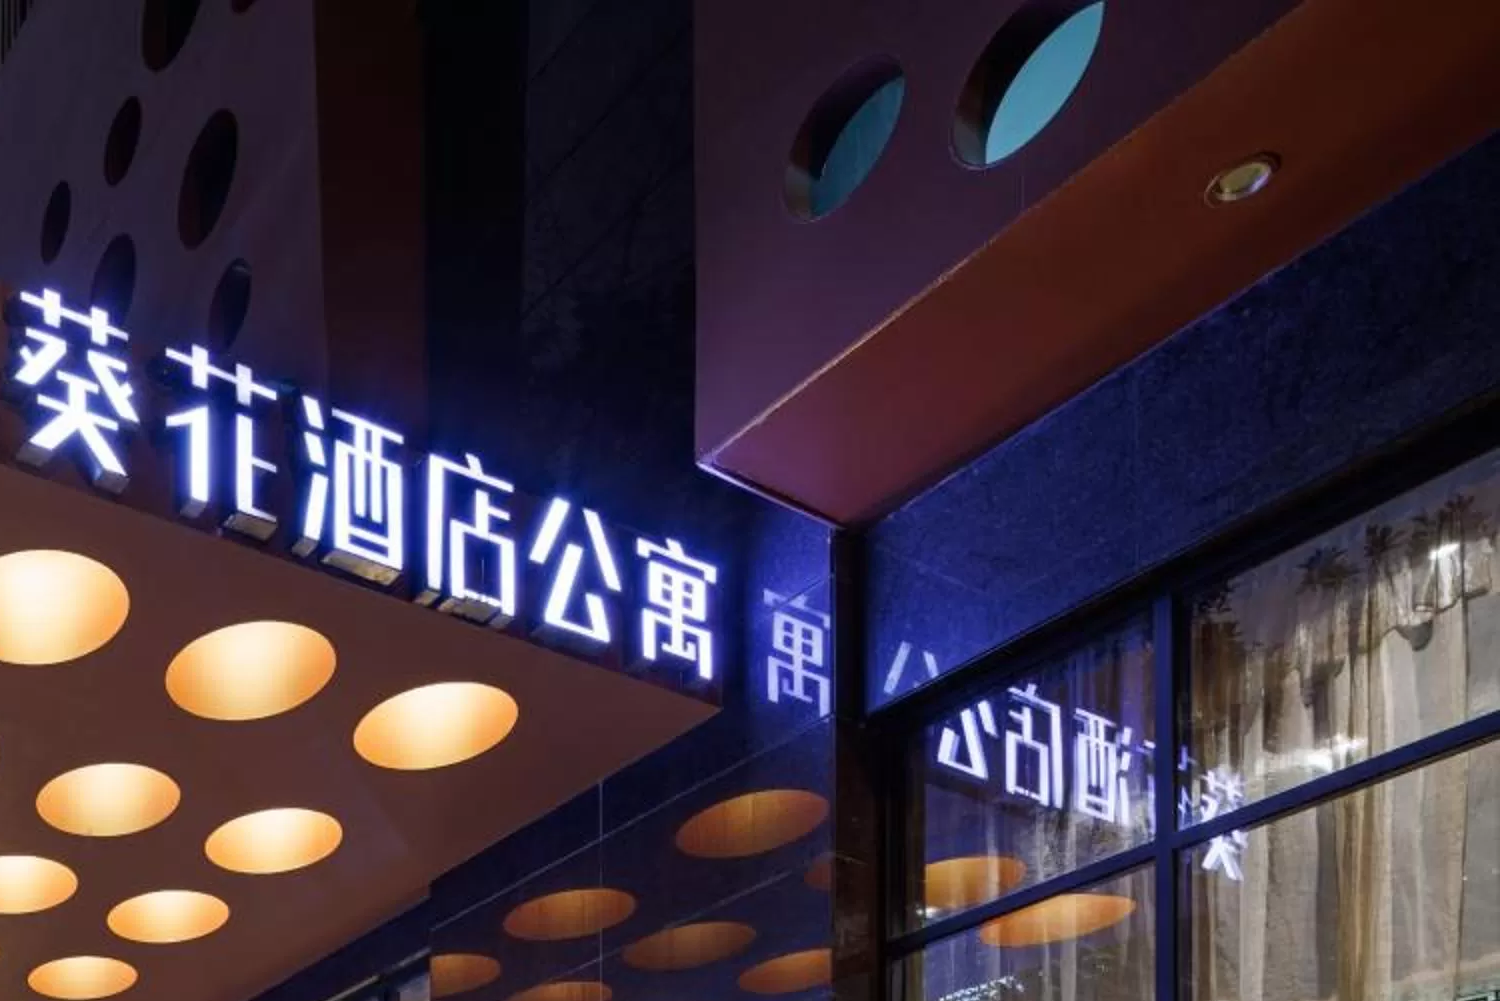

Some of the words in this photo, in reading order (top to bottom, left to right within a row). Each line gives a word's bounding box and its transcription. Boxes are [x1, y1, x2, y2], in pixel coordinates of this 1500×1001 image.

[13, 287, 718, 681] 葵花酒店公寓
